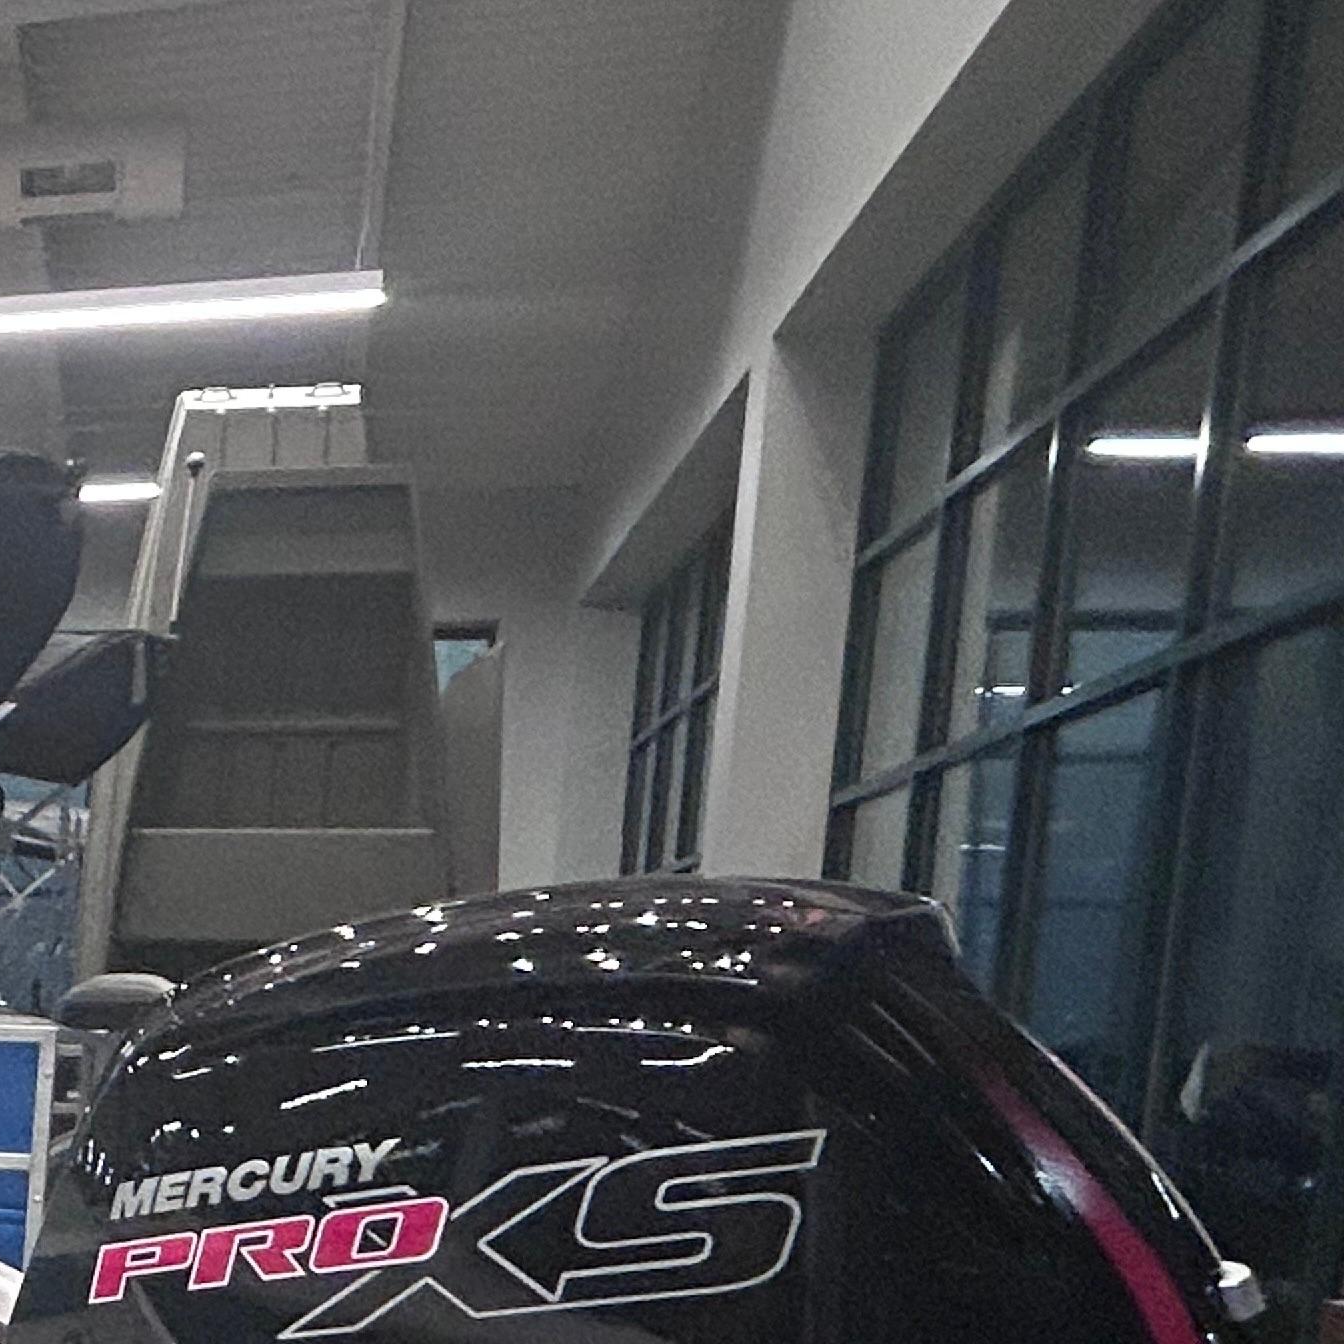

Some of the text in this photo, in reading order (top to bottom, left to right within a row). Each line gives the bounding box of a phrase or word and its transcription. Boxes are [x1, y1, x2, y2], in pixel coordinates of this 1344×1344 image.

[88, 1129, 828, 1341] PRO XS
[110, 1137, 402, 1220] MERCURY
